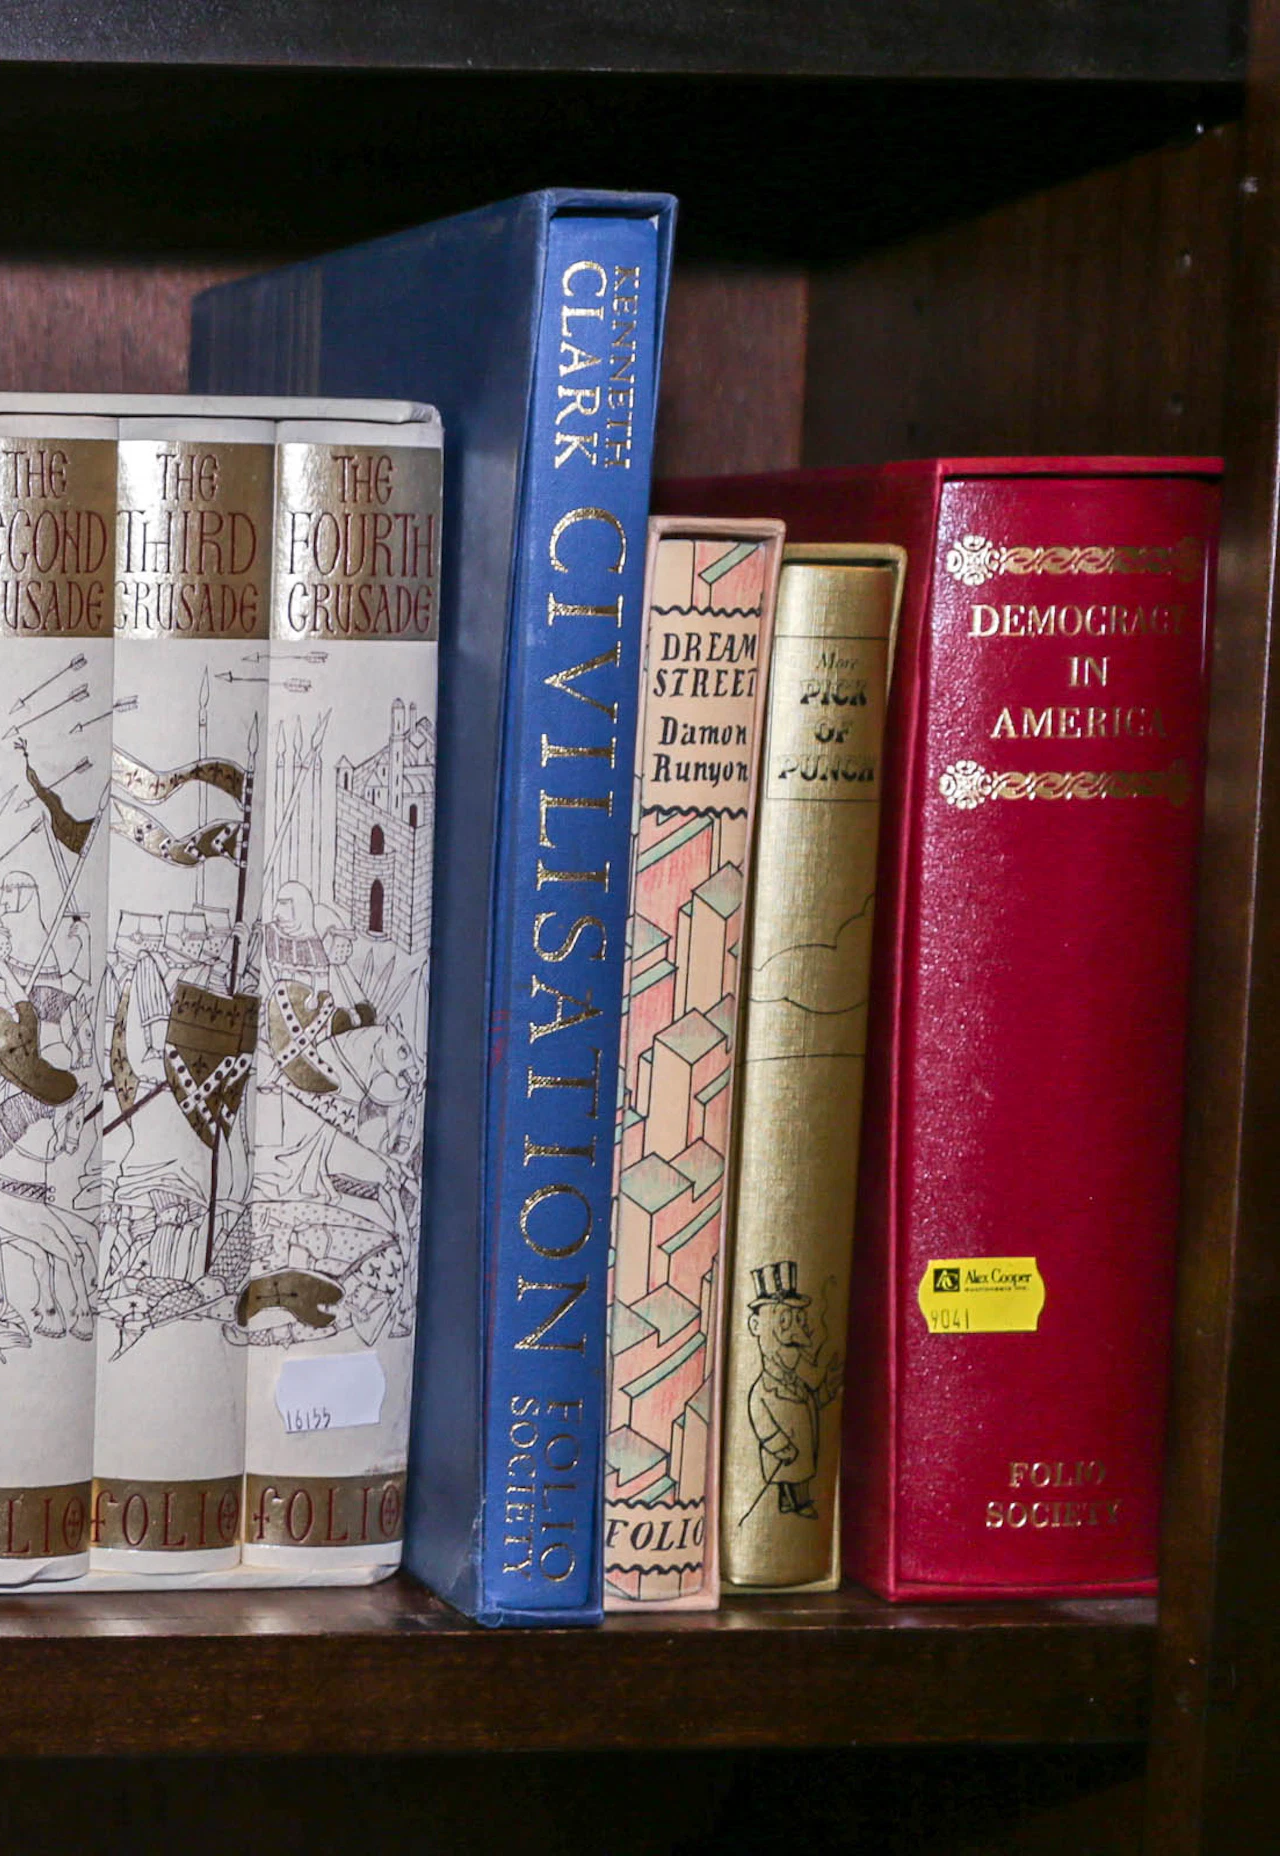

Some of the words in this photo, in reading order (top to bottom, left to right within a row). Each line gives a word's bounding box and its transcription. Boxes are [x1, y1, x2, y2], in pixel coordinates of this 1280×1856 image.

[554, 259, 608, 469] CLARK
[604, 265, 640, 469] KENNETH
[2, 449, 68, 500] THE
[156, 454, 219, 501] THE
[331, 454, 393, 505] THE
[118, 510, 257, 575] THIRD
[290, 513, 433, 579] FOURTH
[114, 580, 258, 633] CRUSADE
[288, 583, 431, 633] CRUSADE
[661, 632, 757, 663] DREAM
[1068, 656, 1110, 687] IN
[658, 716, 747, 746] Damon
[990, 707, 1169, 739] AMERICA
[650, 754, 749, 787] Runyon
[514, 506, 628, 1357] CIVILISATION
[965, 1269, 988, 1284] Alex
[991, 1268, 1032, 1286] Cooper
[502, 1395, 540, 1581] SOCIETY
[540, 1399, 585, 1583] FOLIO
[1009, 1461, 1106, 1488] FOLIO
[90, 1491, 237, 1547] FOLIO
[253, 1480, 400, 1541] FOLIO
[986, 1500, 1122, 1528] SOCIETY
